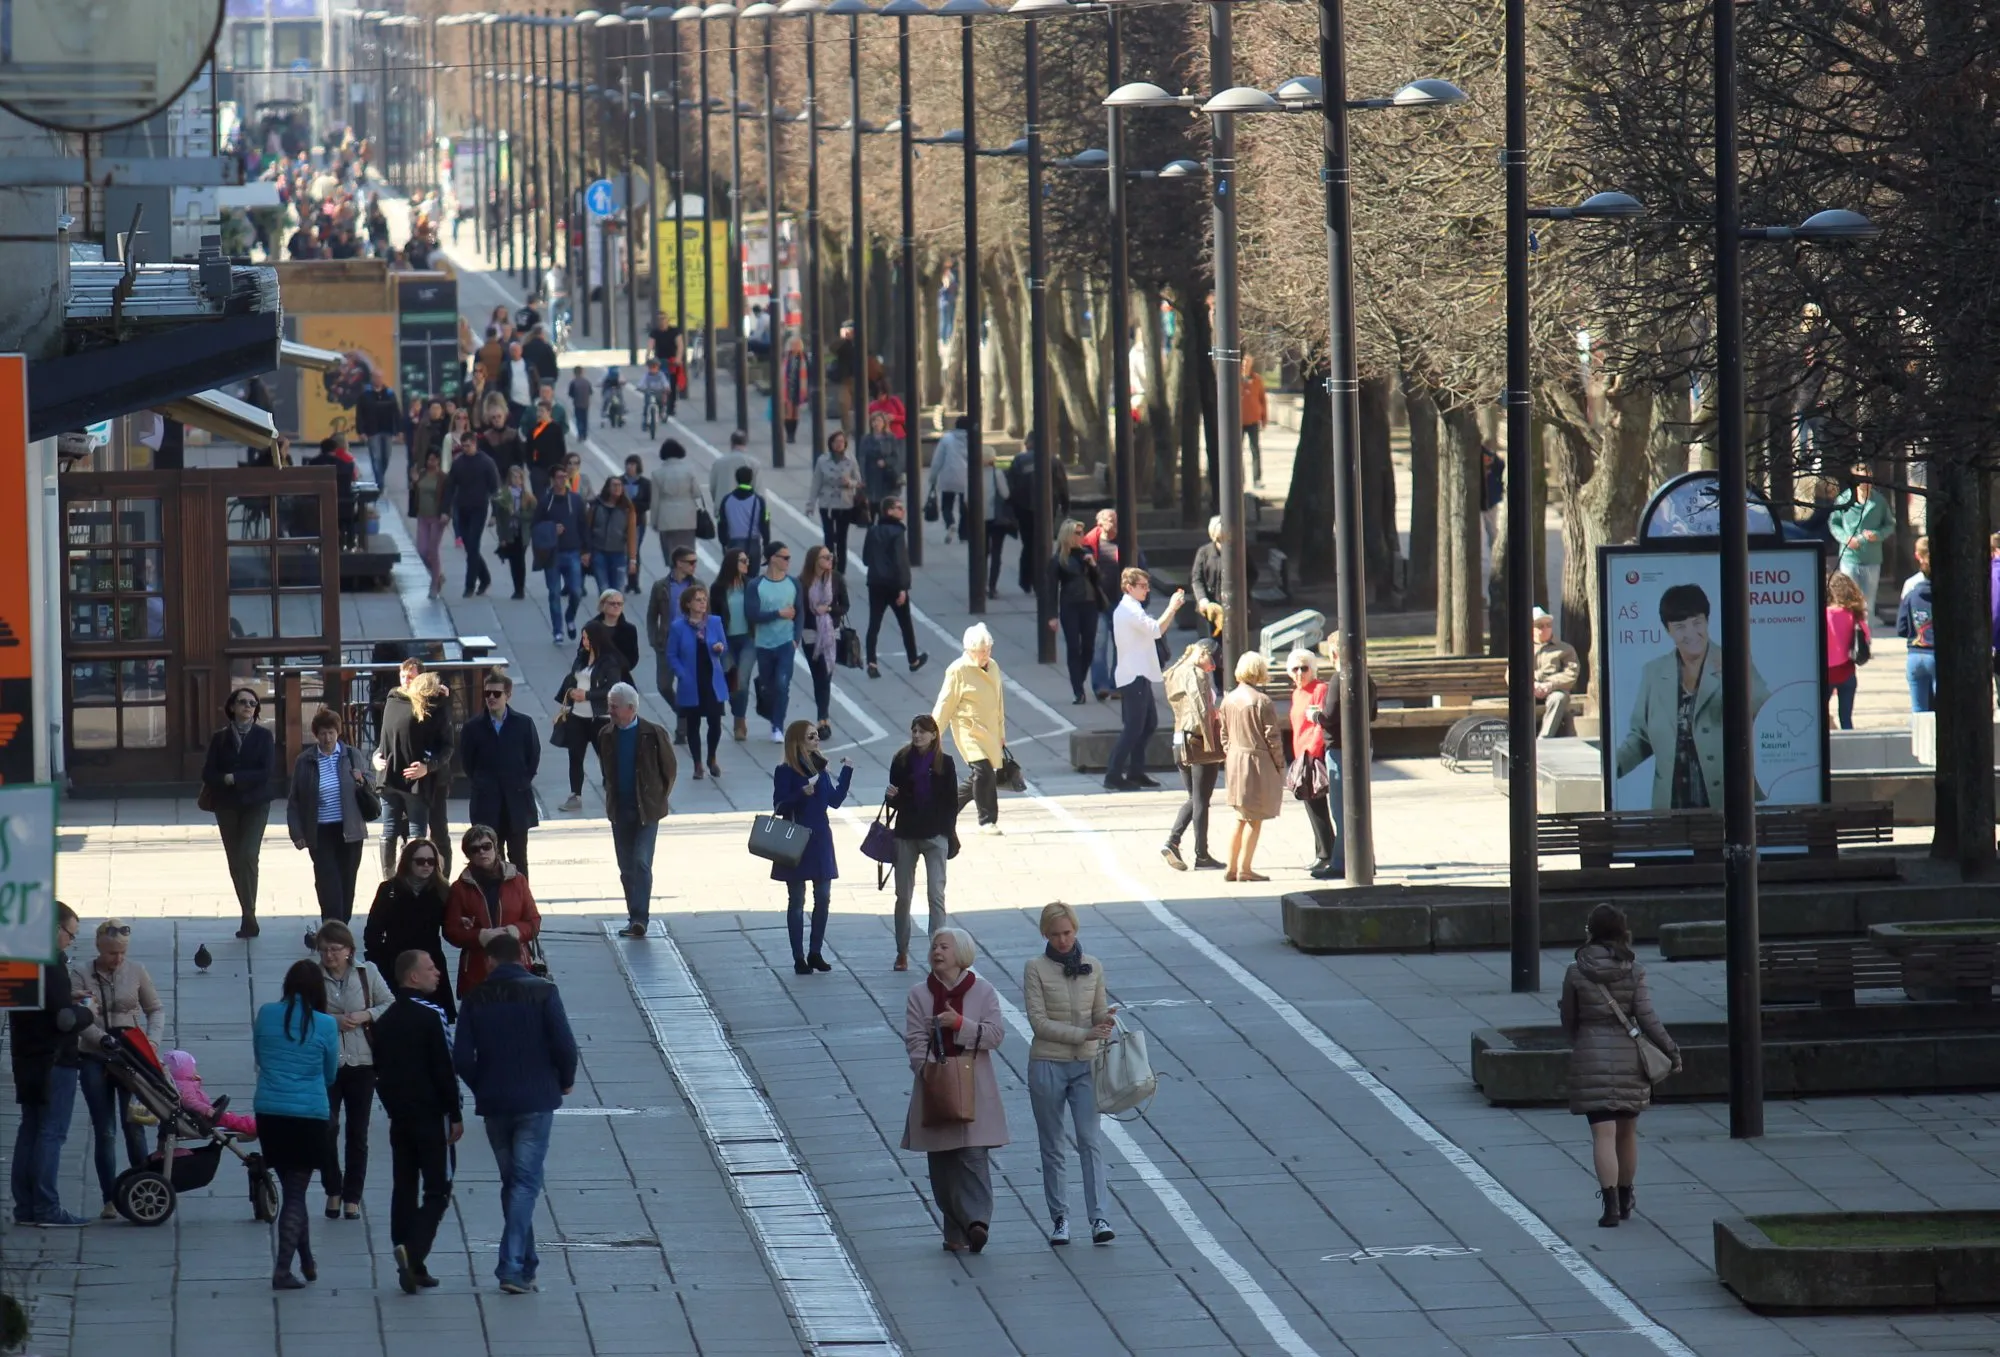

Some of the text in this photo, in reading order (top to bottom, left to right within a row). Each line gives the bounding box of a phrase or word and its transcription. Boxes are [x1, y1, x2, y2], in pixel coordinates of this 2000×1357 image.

[1749, 569, 1791, 585] IENO
[1749, 589, 1805, 606] RAUJO
[1618, 601, 1638, 619] AŠ
[1620, 630, 1661, 645] IR TU
